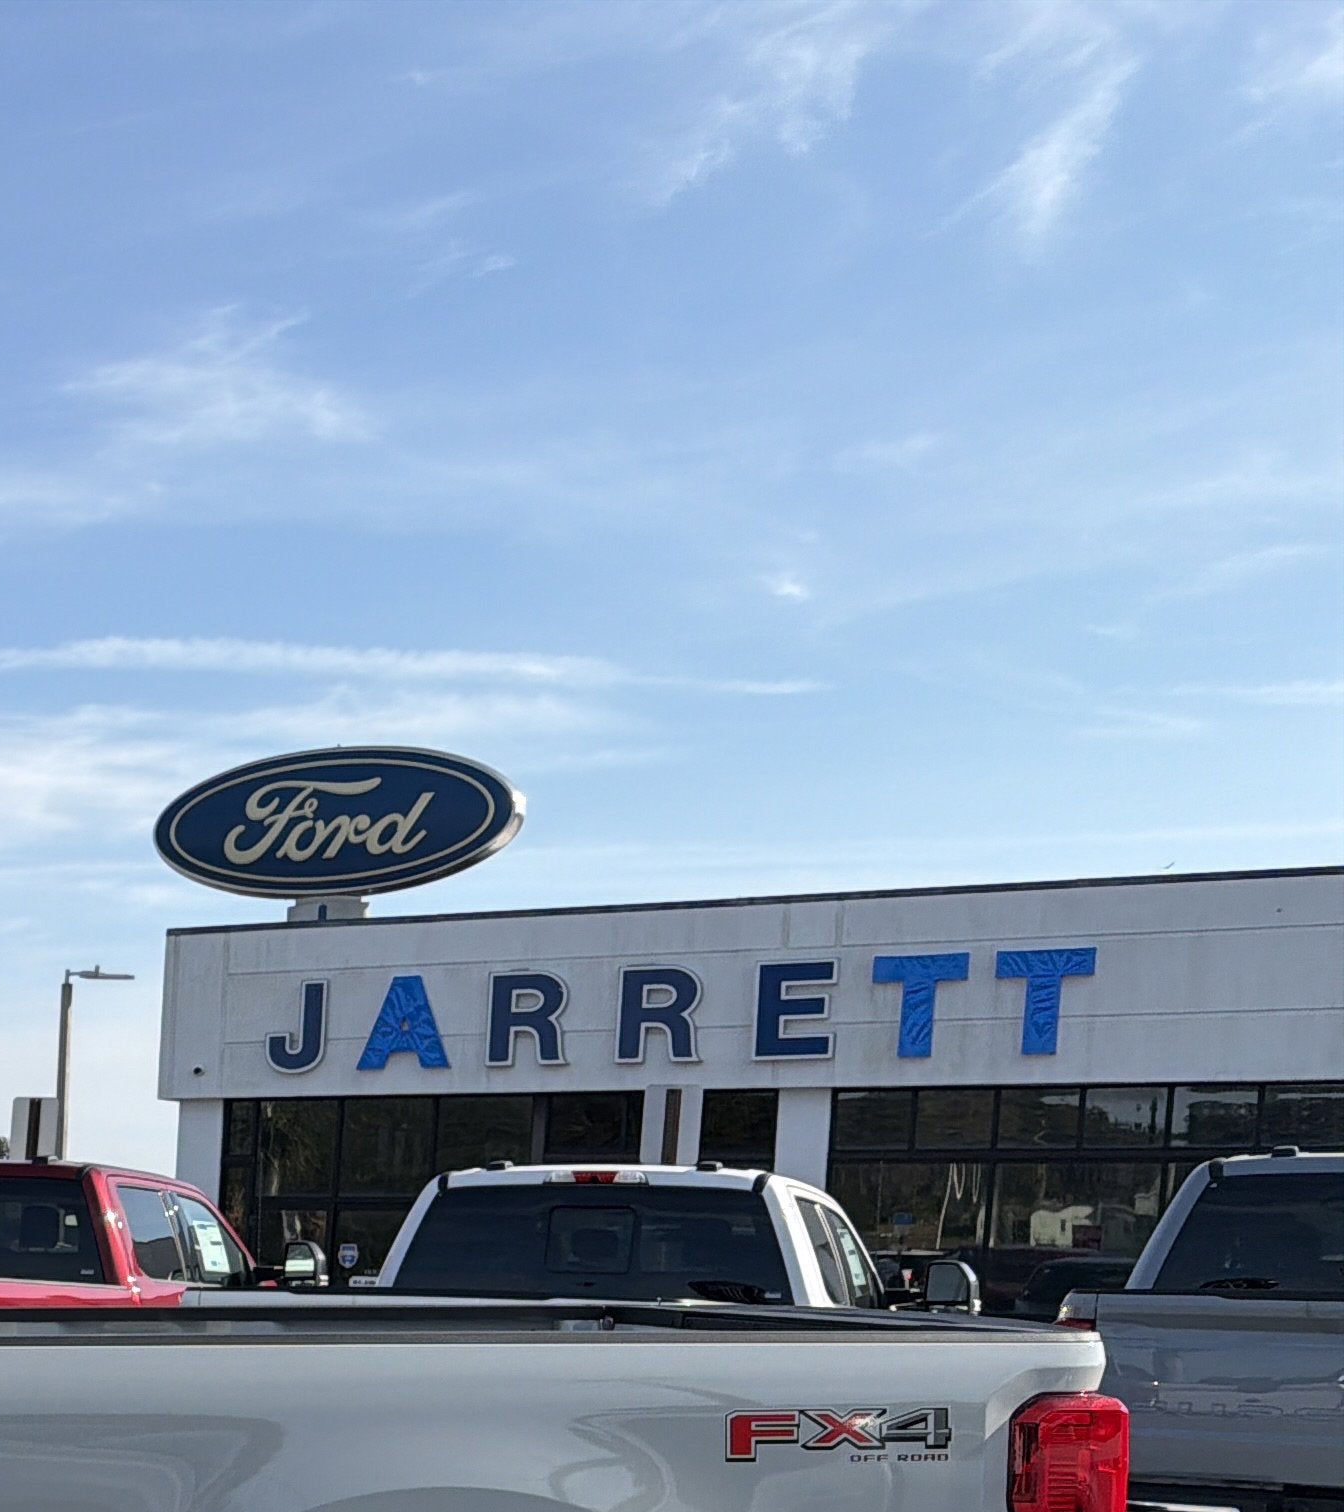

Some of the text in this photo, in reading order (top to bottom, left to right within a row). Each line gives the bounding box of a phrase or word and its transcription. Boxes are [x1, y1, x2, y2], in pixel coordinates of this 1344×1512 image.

[223, 776, 436, 865] Ford
[265, 946, 1098, 1075] JARRETT
[724, 1407, 952, 1463] FX4
[849, 1453, 950, 1463] OFF ROAD
